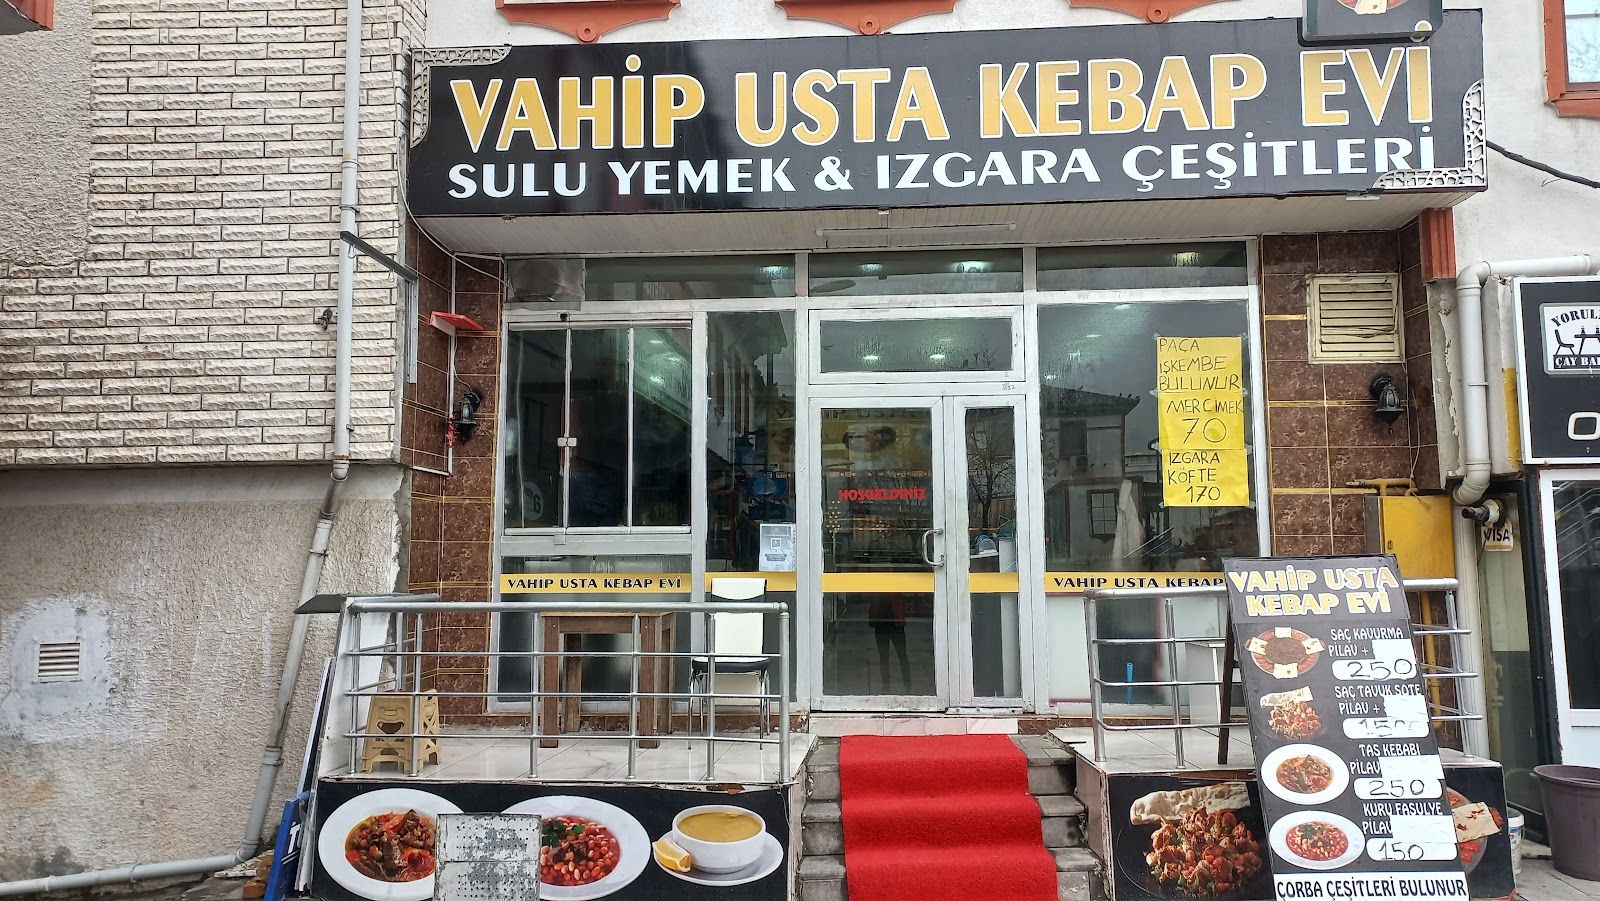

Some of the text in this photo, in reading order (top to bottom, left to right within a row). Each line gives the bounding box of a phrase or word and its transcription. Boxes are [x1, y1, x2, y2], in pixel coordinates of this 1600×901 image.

[450, 20, 1434, 153] VAHİP USTA KEBAP EVİ
[447, 126, 1435, 199] SULU YEMEK & IZGARA ÇEŞİTLERİ
[1550, 309, 1600, 327] YORUL
[1159, 338, 1200, 353] PAÇA
[1555, 356, 1600, 369] ÇAY BA
[1159, 374, 1240, 391] BULUNUR
[1181, 417, 1227, 444] 70
[1169, 451, 1220, 465] IZGARA
[1167, 467, 1217, 485] KÖFTE
[1186, 486, 1221, 503] 170
[1483, 528, 1511, 542] VISA
[508, 576, 681, 589] VAHİP USTA KEBAP EVİ
[1053, 575, 1107, 588] VAHİP
[1114, 577, 1159, 588] USTA
[1228, 565, 1400, 593] VAHİP USTA
[1246, 587, 1391, 617] KEBAP EVİ
[1330, 627, 1404, 643] SAÇ KAVURMA
[1328, 642, 1358, 657] PİLAV
[1346, 658, 1413, 681] 250
[1334, 685, 1356, 700] SAÇ
[1357, 684, 1393, 698] TAVUK
[1339, 700, 1369, 715] PİLAV
[1359, 742, 1421, 757] TAS KEBABI
[1368, 779, 1425, 798] 250
[1363, 802, 1443, 817] KURU FASULYE
[1378, 840, 1425, 861] 150
[1277, 876, 1468, 901] ÇORBA ÇEŞİTLERİ BULUNUR
